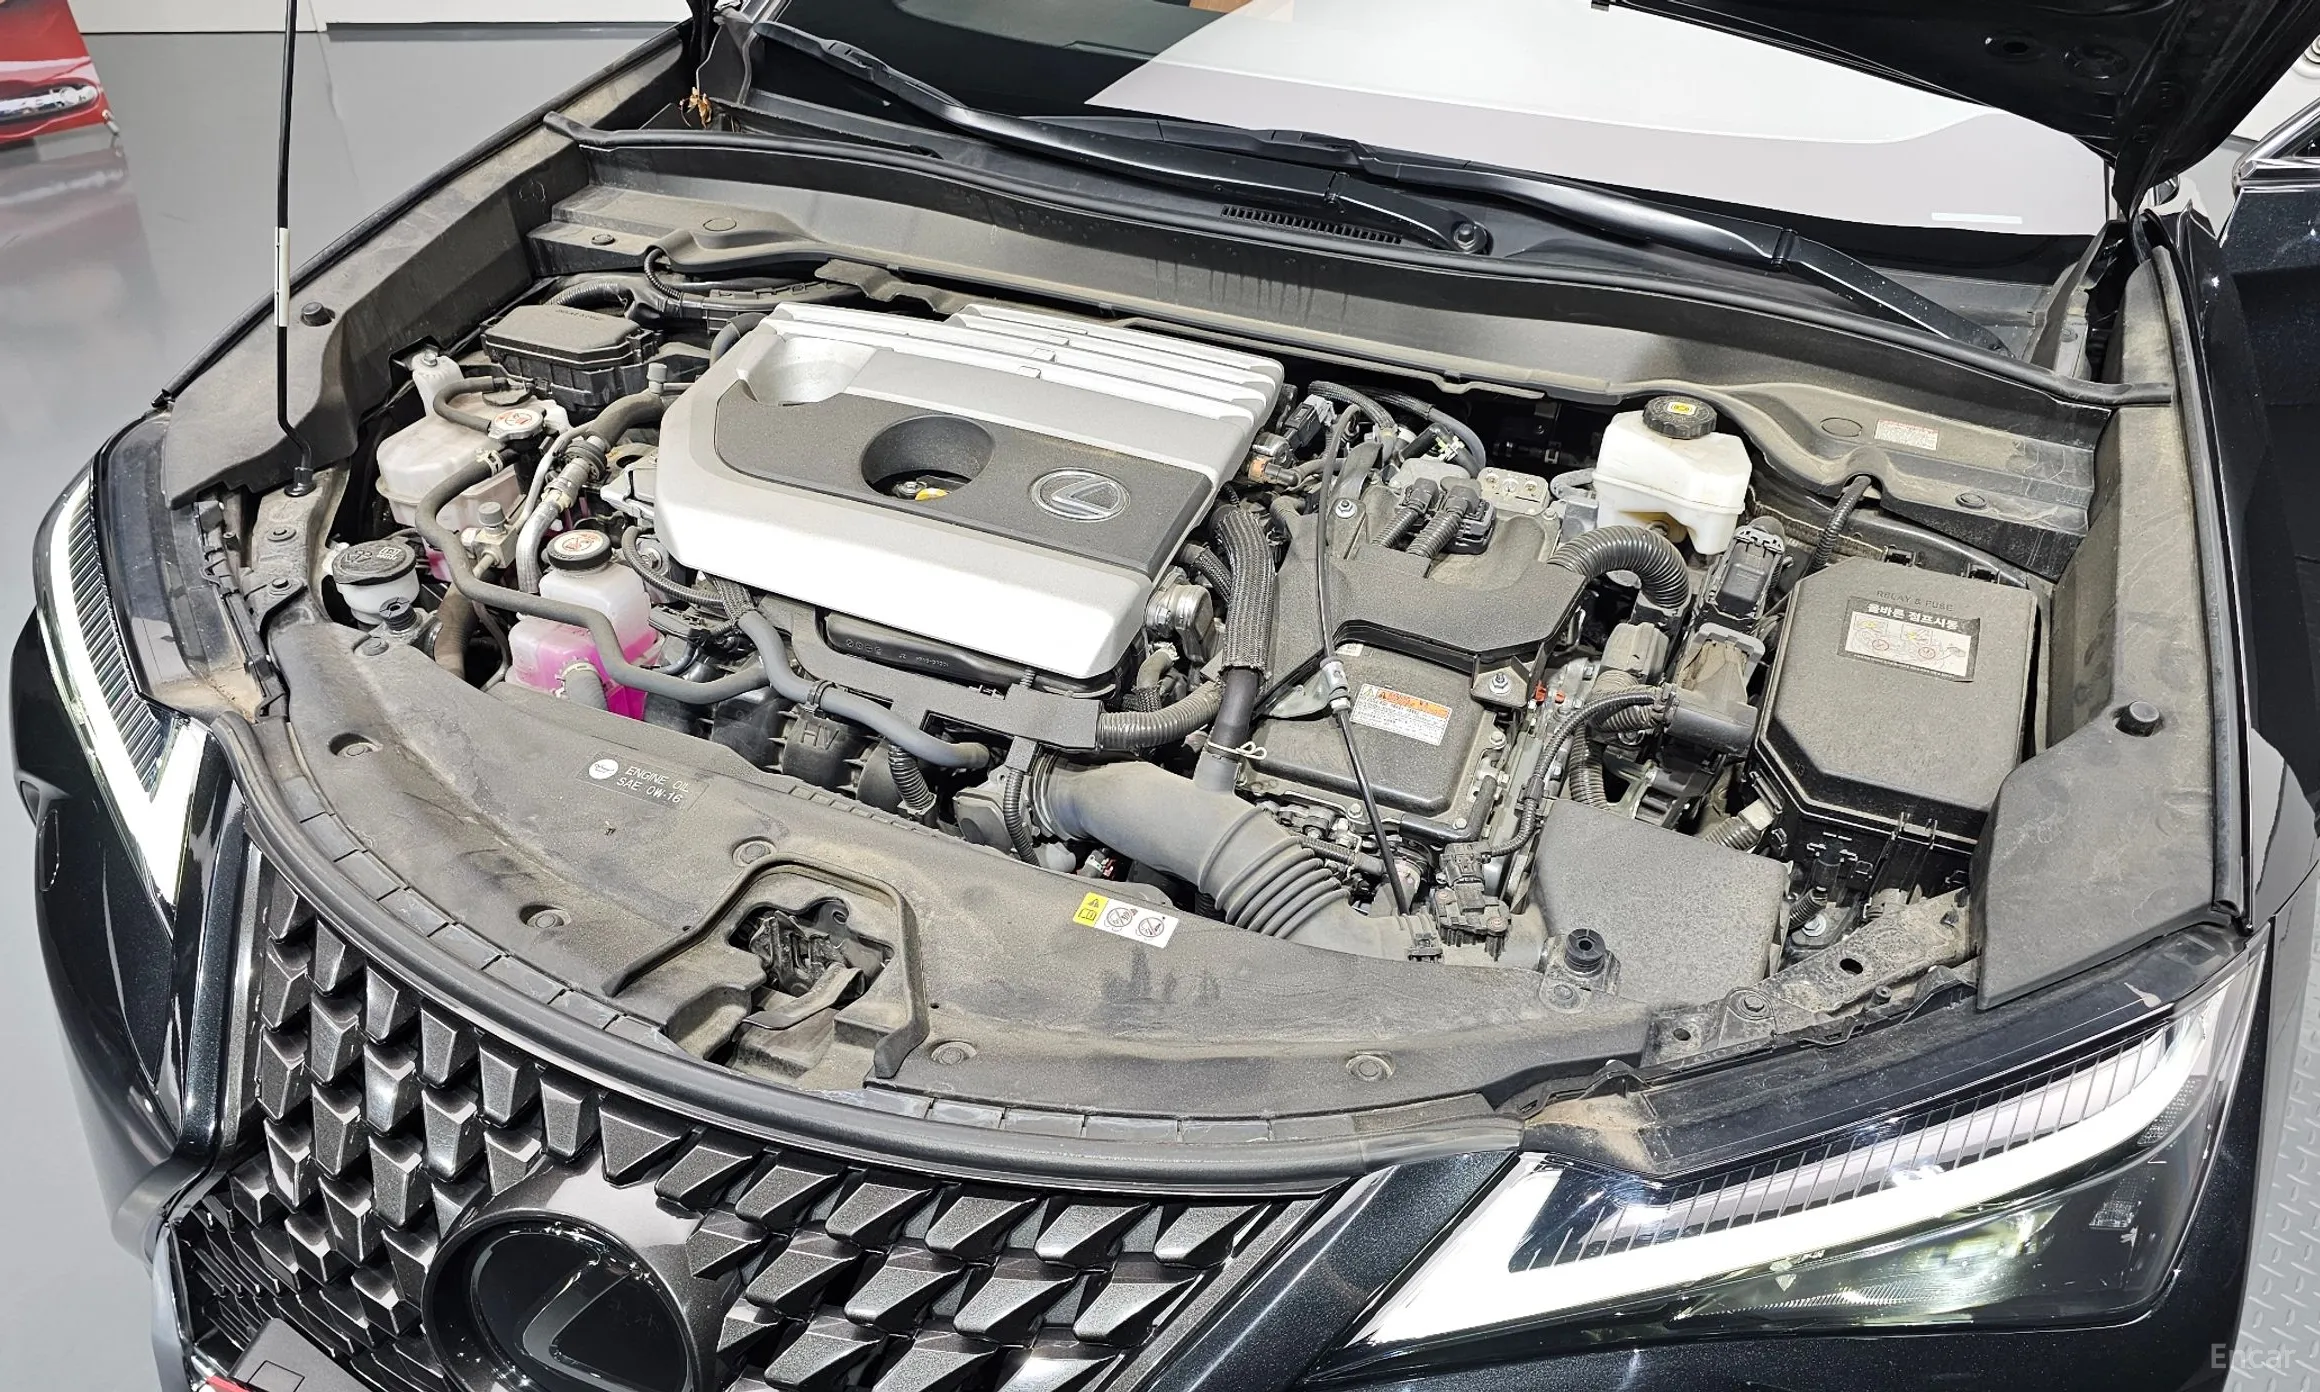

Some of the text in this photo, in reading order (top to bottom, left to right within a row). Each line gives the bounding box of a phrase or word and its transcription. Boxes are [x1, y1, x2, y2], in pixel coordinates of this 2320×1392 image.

[1876, 590, 1955, 612] RELAY & FUSE
[616, 777, 684, 803] SAE 0W-16
[625, 766, 669, 785] ENGINE
[672, 780, 691, 793] OIL
